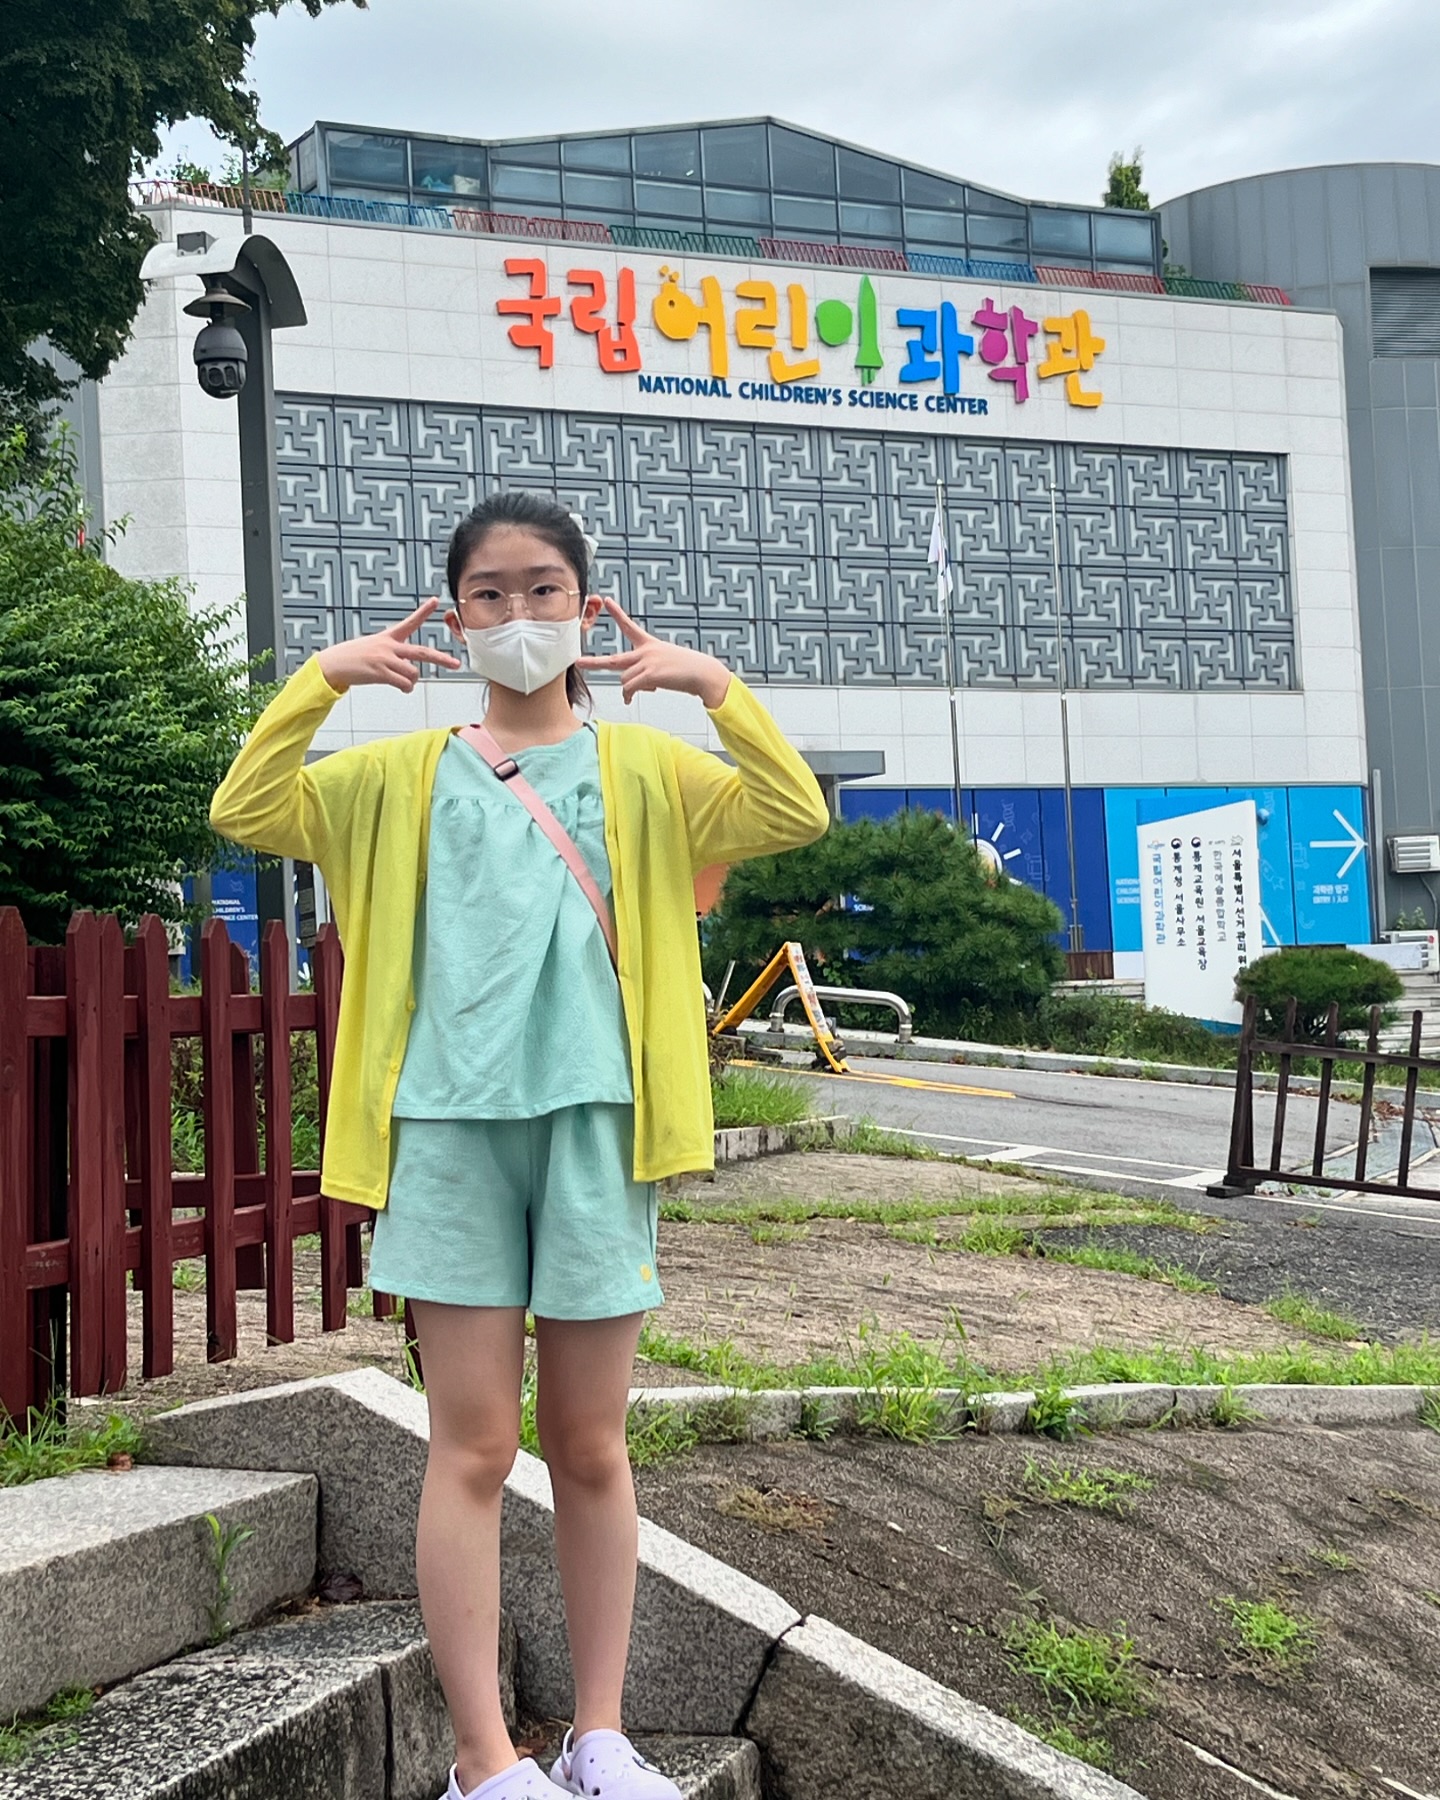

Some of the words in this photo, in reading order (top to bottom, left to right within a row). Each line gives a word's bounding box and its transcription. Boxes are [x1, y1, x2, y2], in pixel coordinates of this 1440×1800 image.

[638, 374, 732, 399] NATIONAL
[738, 382, 842, 407] CHILDREN'S
[848, 389, 919, 412] SCIENCE
[924, 395, 989, 416] CENTER
[1171, 851, 1183, 888] 통계청
[1192, 850, 1204, 909] 통계교육원
[1174, 893, 1187, 947] 서울사무소
[1195, 915, 1208, 971] 서울교육장
